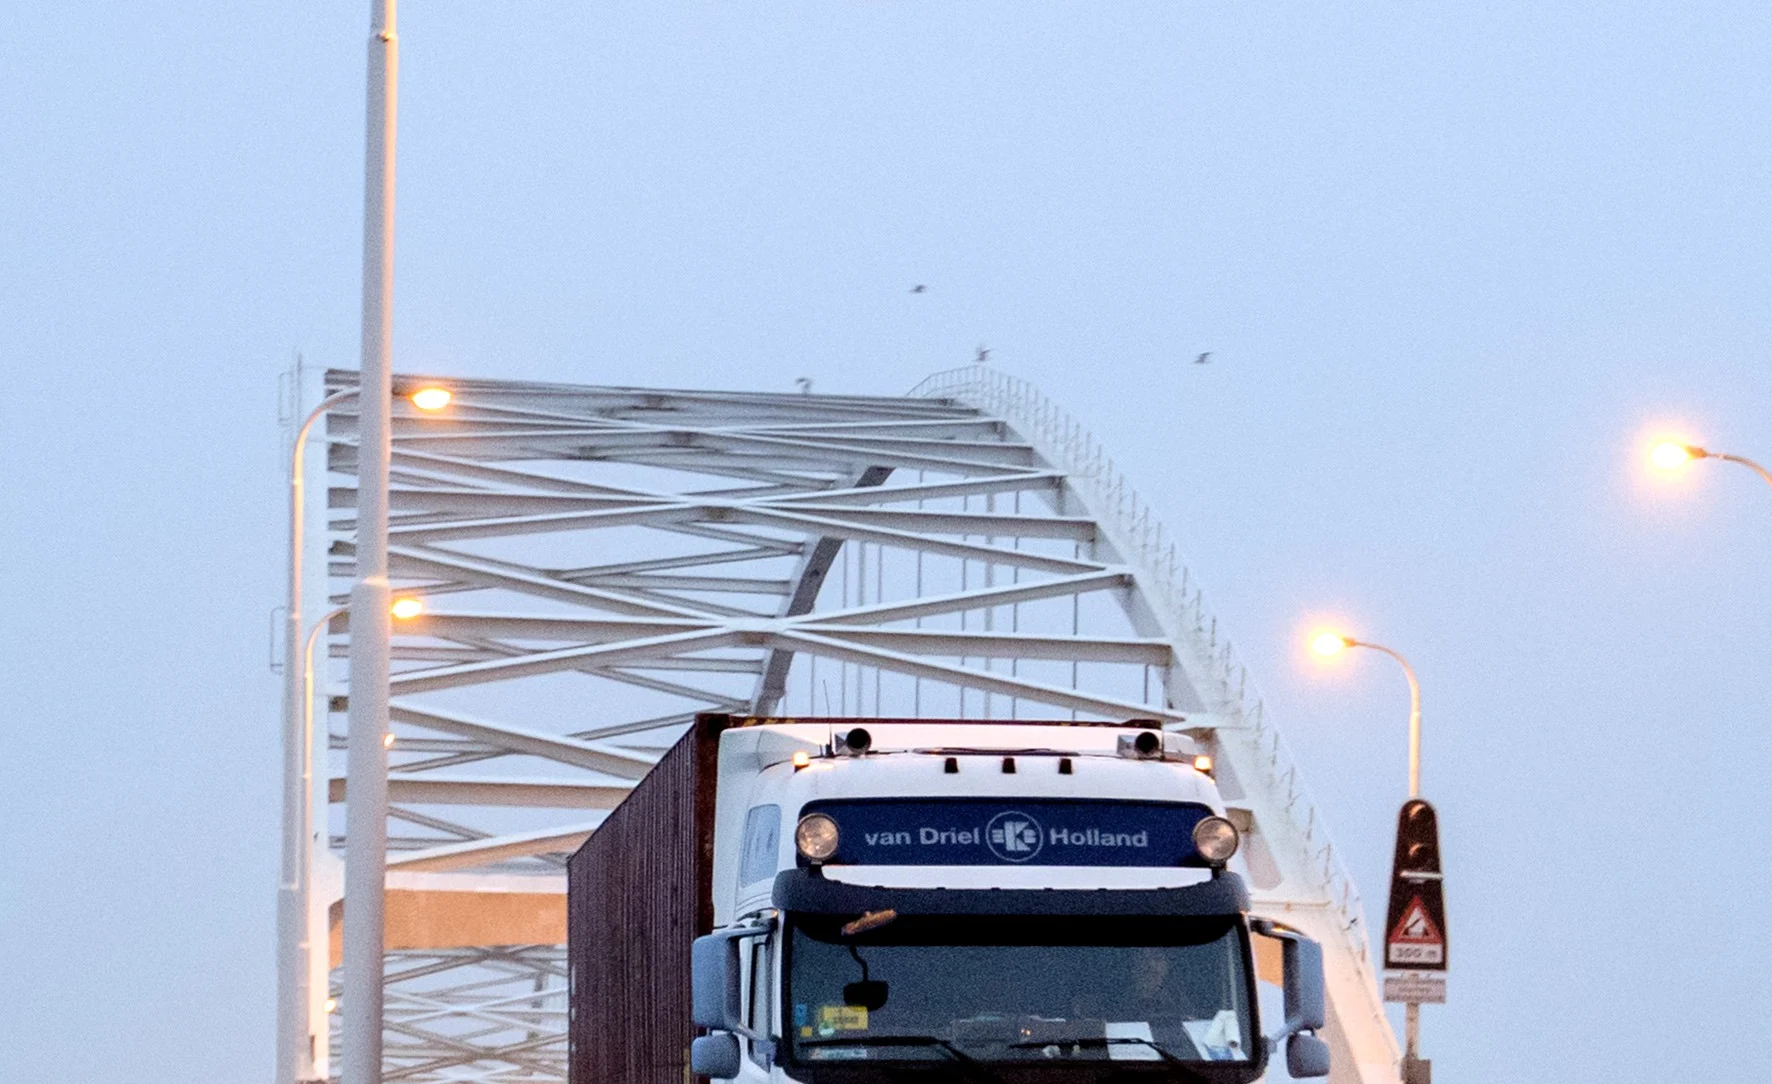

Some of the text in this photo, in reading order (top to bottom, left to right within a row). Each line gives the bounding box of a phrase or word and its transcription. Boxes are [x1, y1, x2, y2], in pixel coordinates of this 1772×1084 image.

[865, 831, 911, 846] van
[919, 827, 980, 845] Driel
[1050, 828, 1149, 847] Holland
